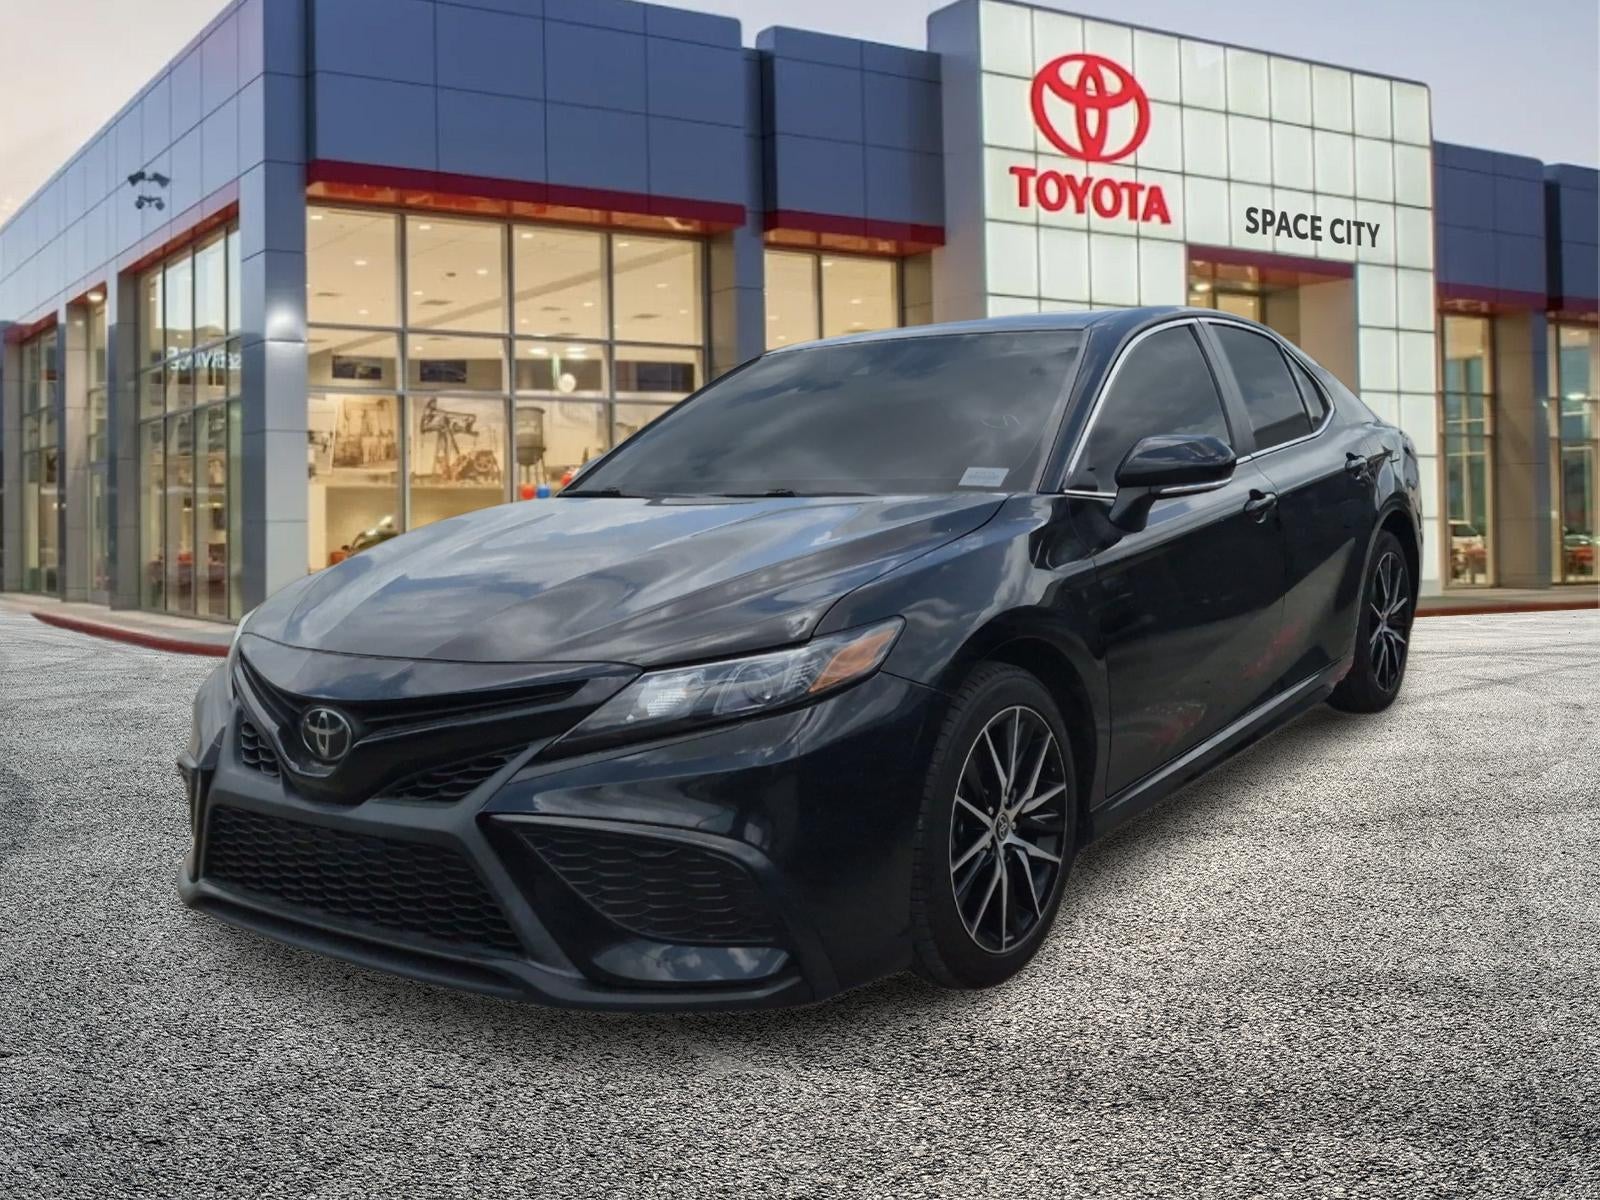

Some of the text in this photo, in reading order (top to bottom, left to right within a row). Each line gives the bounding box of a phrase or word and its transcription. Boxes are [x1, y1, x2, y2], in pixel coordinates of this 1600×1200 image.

[1009, 166, 1171, 224] TOYOTA
[1245, 207, 1380, 247] SPACE CITY
